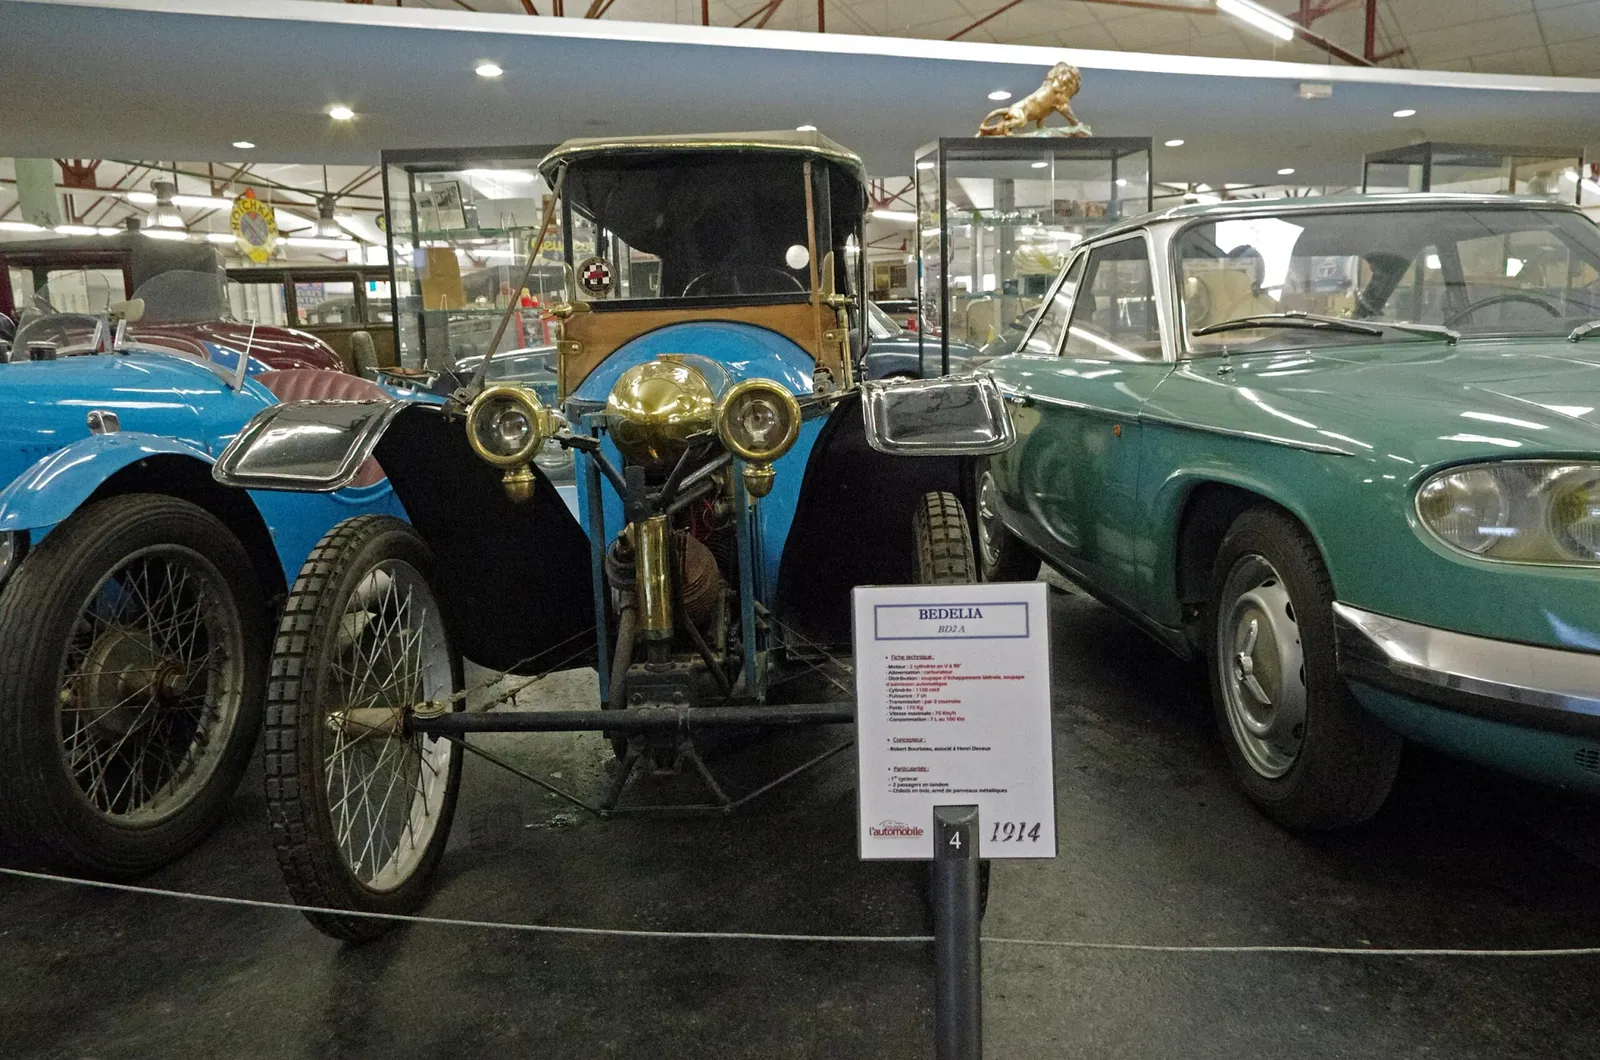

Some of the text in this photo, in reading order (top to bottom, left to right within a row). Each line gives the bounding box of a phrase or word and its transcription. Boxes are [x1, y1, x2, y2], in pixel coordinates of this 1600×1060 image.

[918, 608, 983, 620] BEDELIA
[869, 826, 924, 836] l'automobile
[990, 822, 1041, 842] 1914
[950, 831, 962, 849] 4
